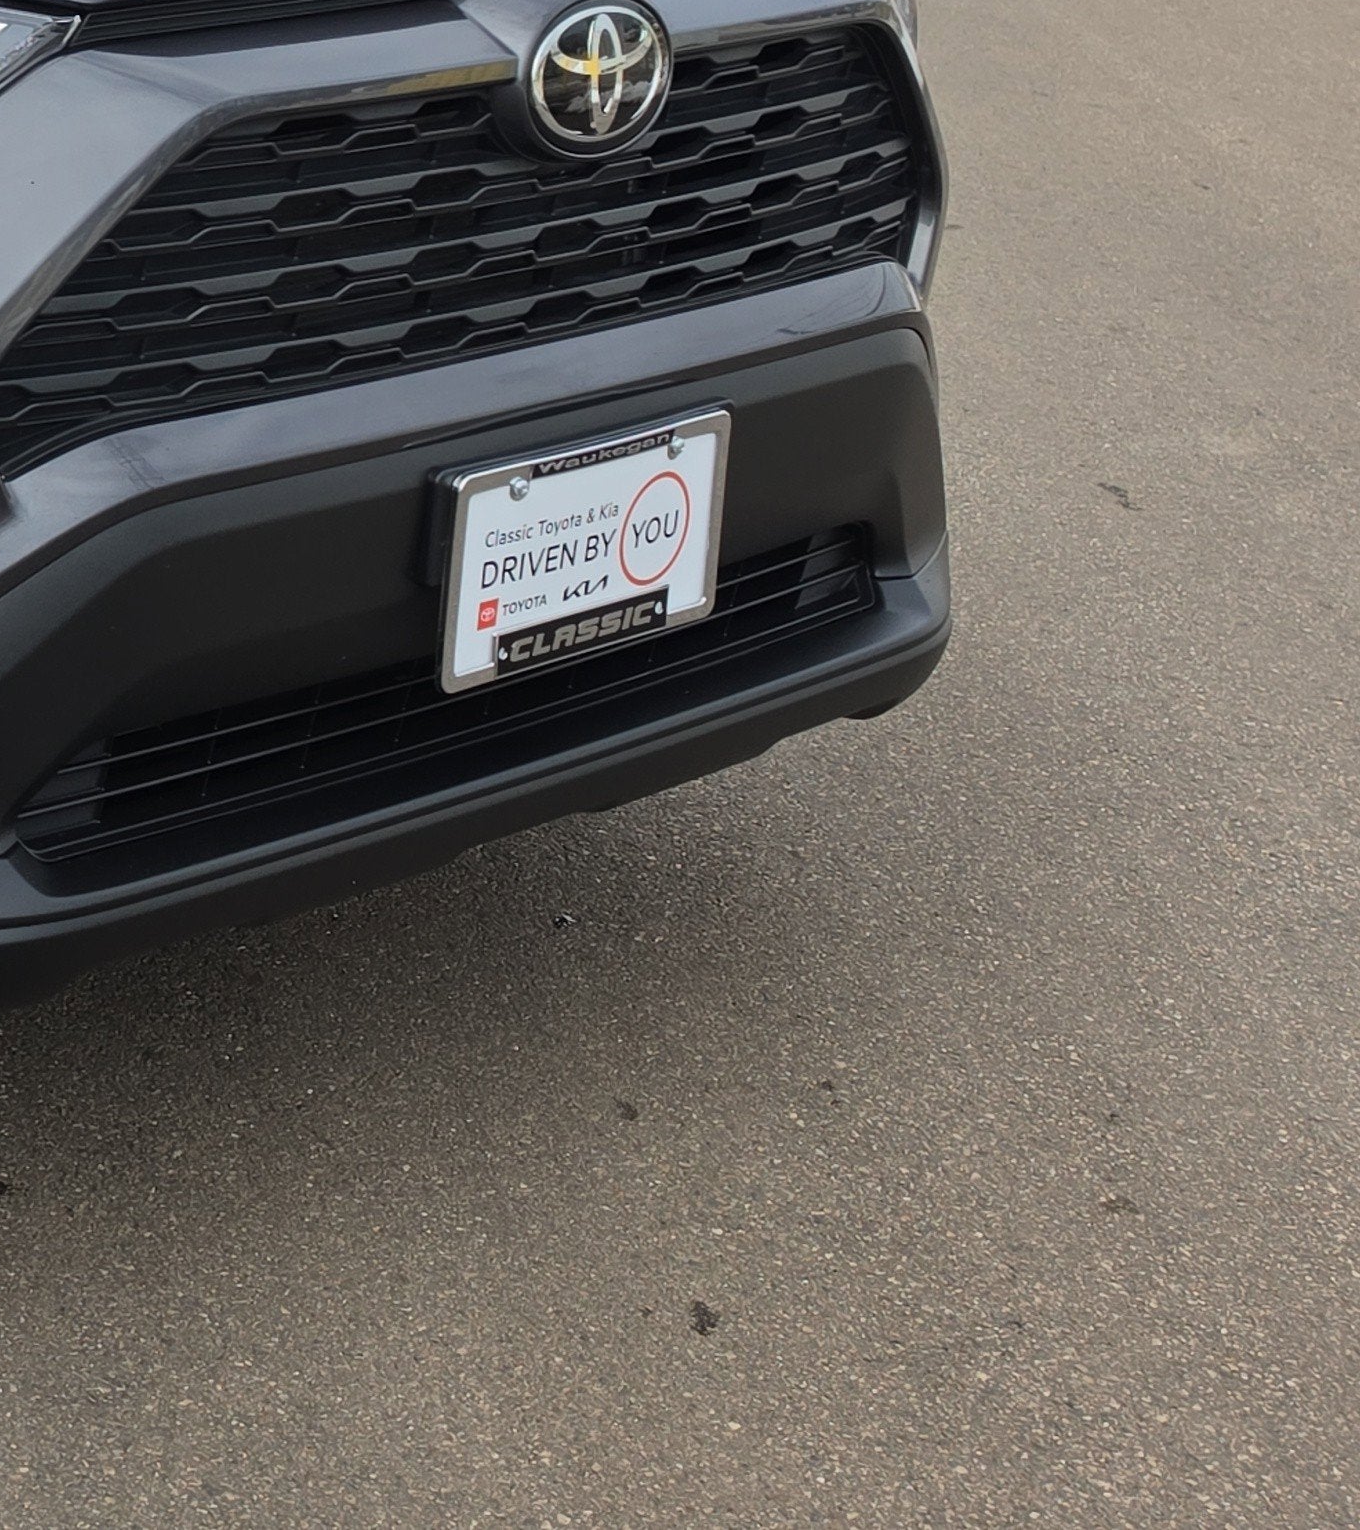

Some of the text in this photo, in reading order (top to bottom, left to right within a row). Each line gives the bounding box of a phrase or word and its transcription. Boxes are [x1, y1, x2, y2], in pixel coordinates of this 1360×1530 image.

[538, 432, 671, 474] Waukegan
[485, 502, 619, 548] Classic Toyota & Kia
[480, 509, 680, 589] DRIVEN BY YOU
[502, 594, 547, 616] TOYOTA
[509, 600, 657, 663] CLASSIC
